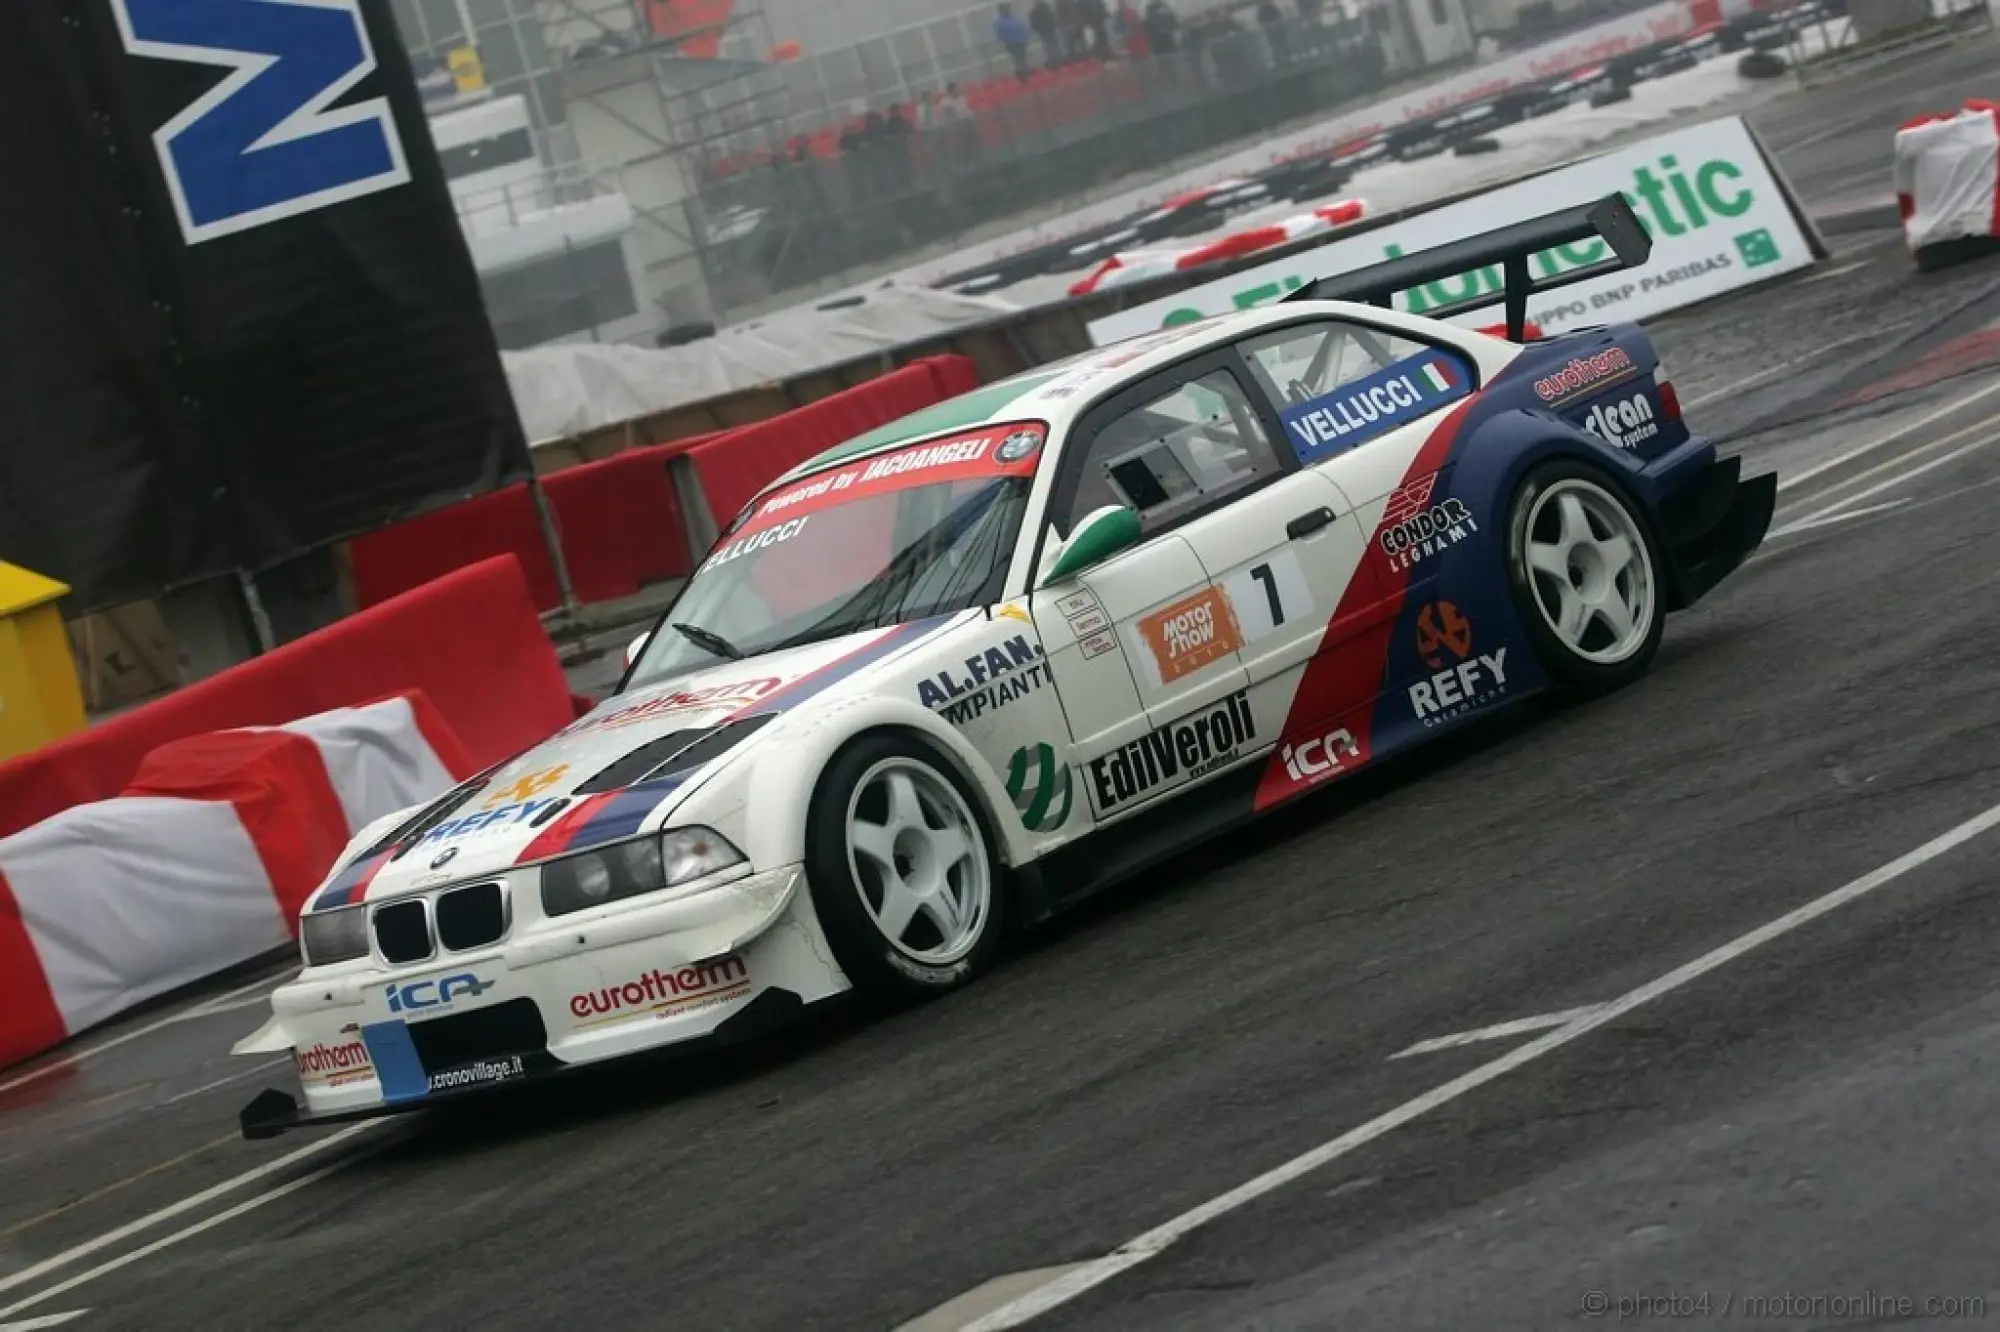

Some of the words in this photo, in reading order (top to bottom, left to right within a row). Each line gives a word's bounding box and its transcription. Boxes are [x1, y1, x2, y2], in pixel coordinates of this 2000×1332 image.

[1593, 283, 1636, 311] BNP
[1639, 252, 1733, 294] PARIBAS
[1533, 346, 1632, 401] eurotherm
[1289, 374, 1423, 447] VELLUCCI
[757, 476, 836, 519] Powered
[831, 470, 859, 491] by
[1380, 498, 1472, 556] CONDOR
[1250, 562, 1286, 627] 1
[1408, 646, 1507, 720] REFY
[1091, 690, 1256, 810] EdilVeroli
[422, 796, 560, 843] REFY
[569, 954, 748, 1018] eurotherm
